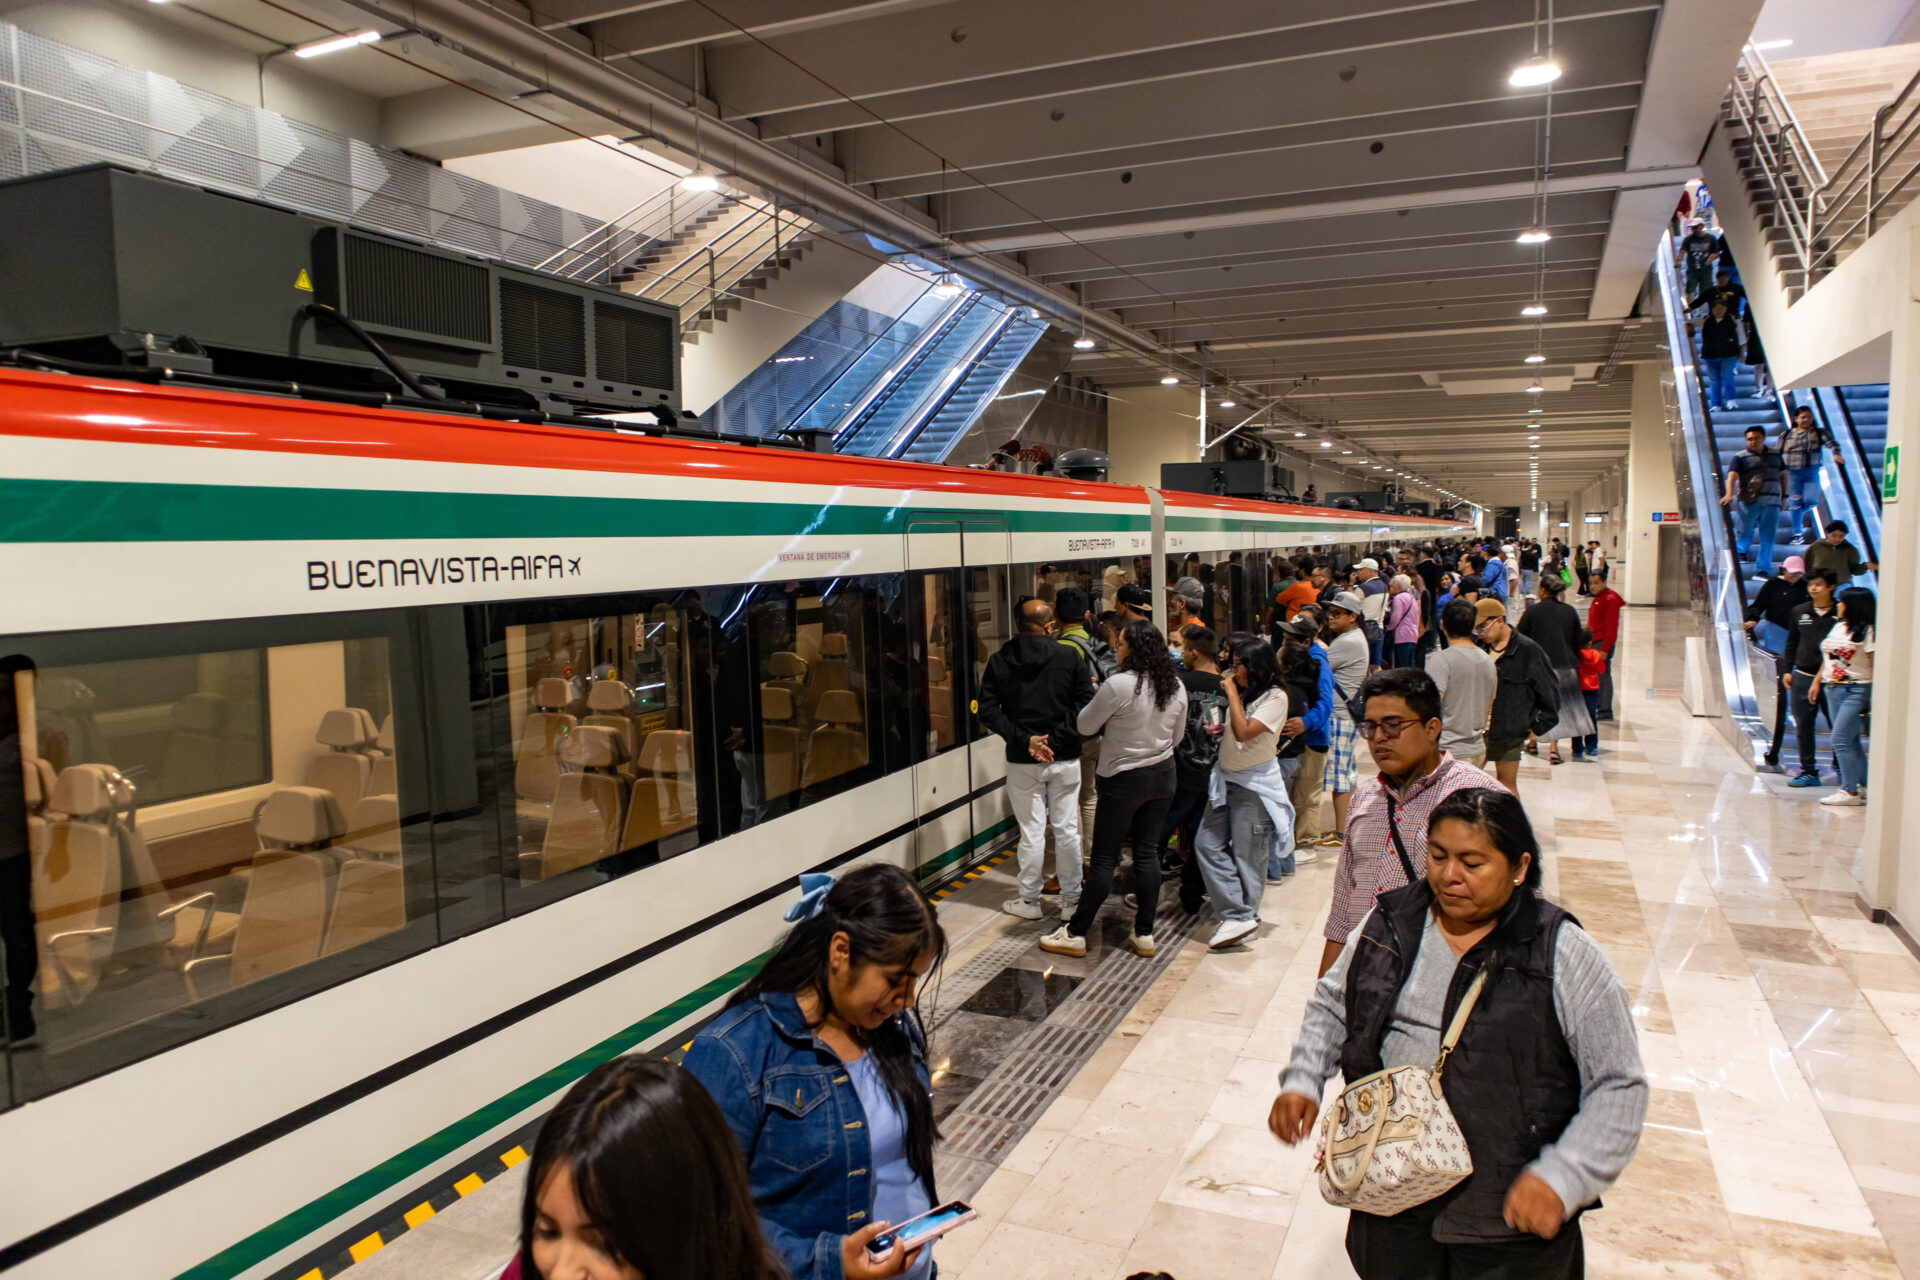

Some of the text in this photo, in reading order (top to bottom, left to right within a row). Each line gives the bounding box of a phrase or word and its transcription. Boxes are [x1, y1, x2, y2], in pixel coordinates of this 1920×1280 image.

[779, 551, 850, 562] VENTANA DE EMERGENCIA
[306, 555, 563, 590] BUENAVISTA-AIFA
